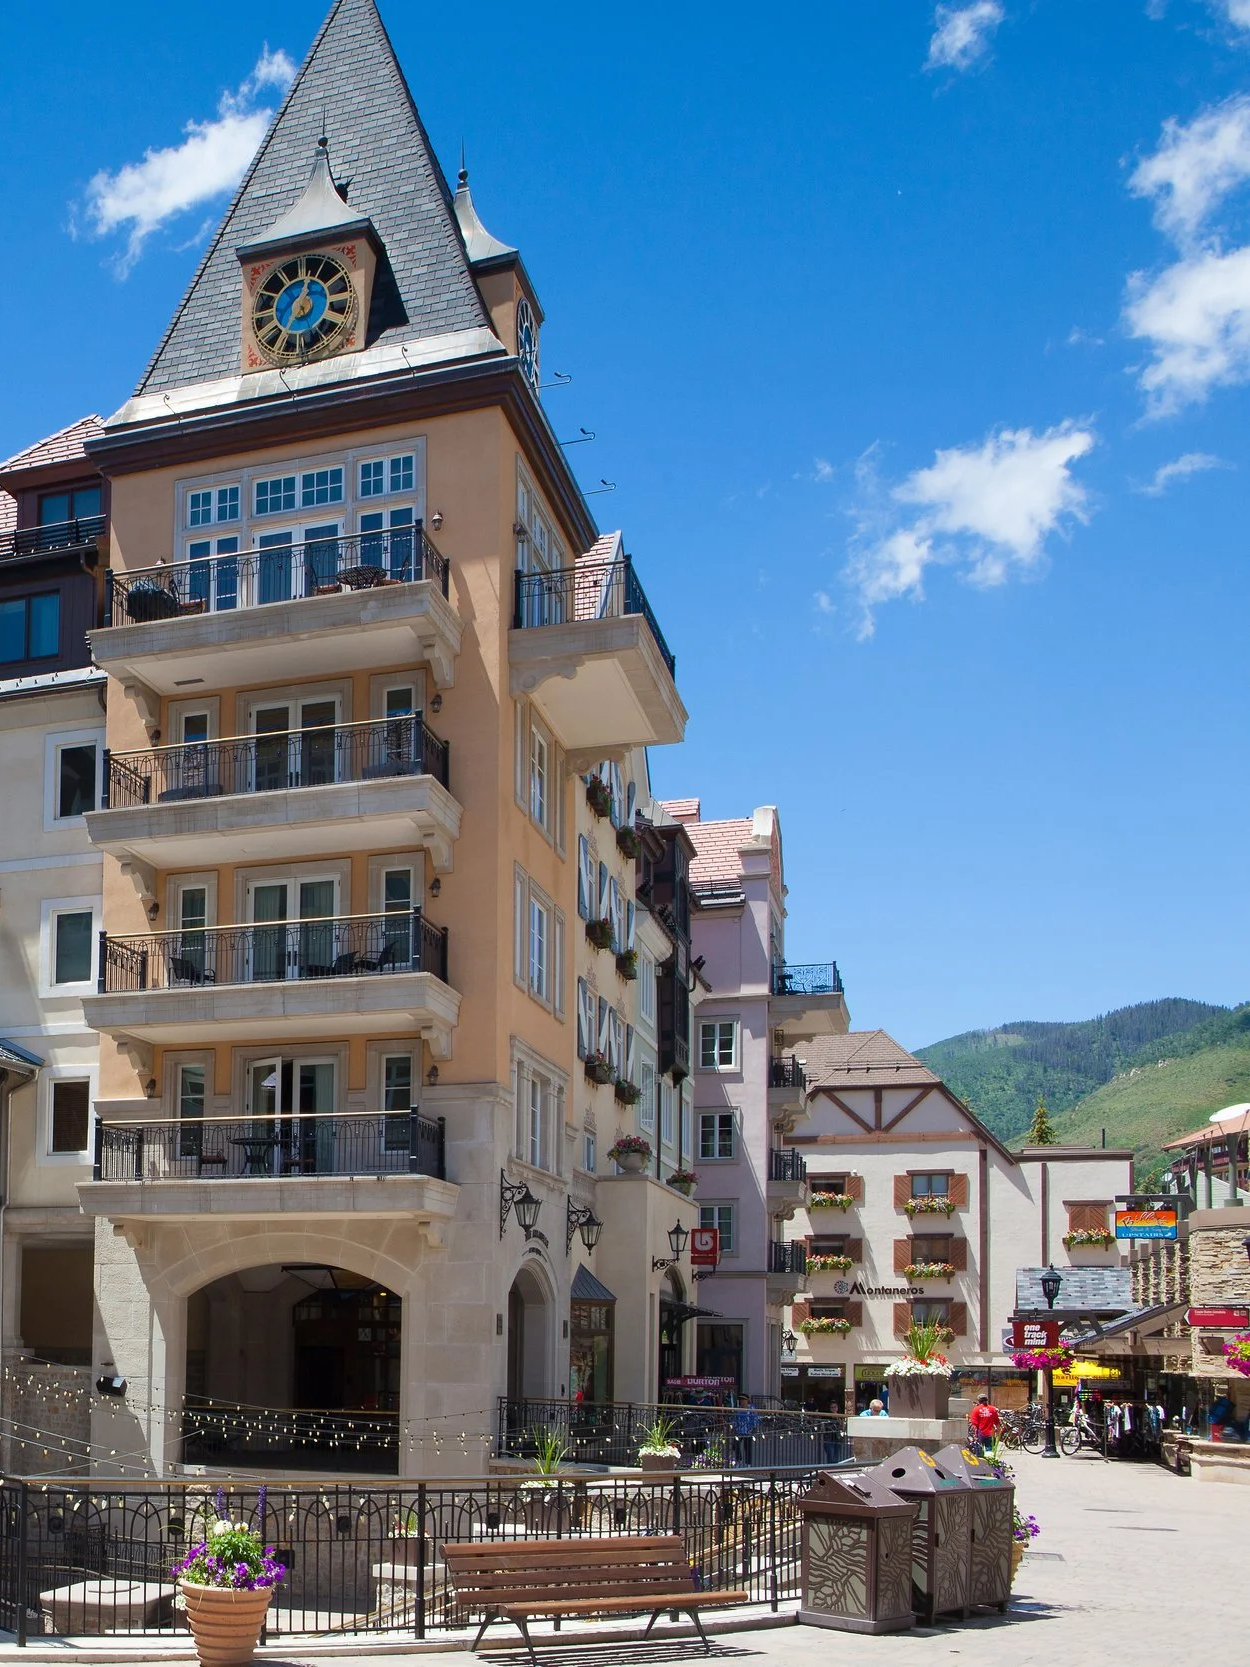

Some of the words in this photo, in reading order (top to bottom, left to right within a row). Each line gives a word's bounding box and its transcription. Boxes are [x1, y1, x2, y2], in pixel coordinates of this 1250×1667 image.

[849, 1281, 925, 1295] Montaneros
[1024, 1324, 1041, 1332] one
[1024, 1331, 1048, 1339] track
[1024, 1337, 1047, 1346] mind
[687, 1378, 720, 1386] BURTON
